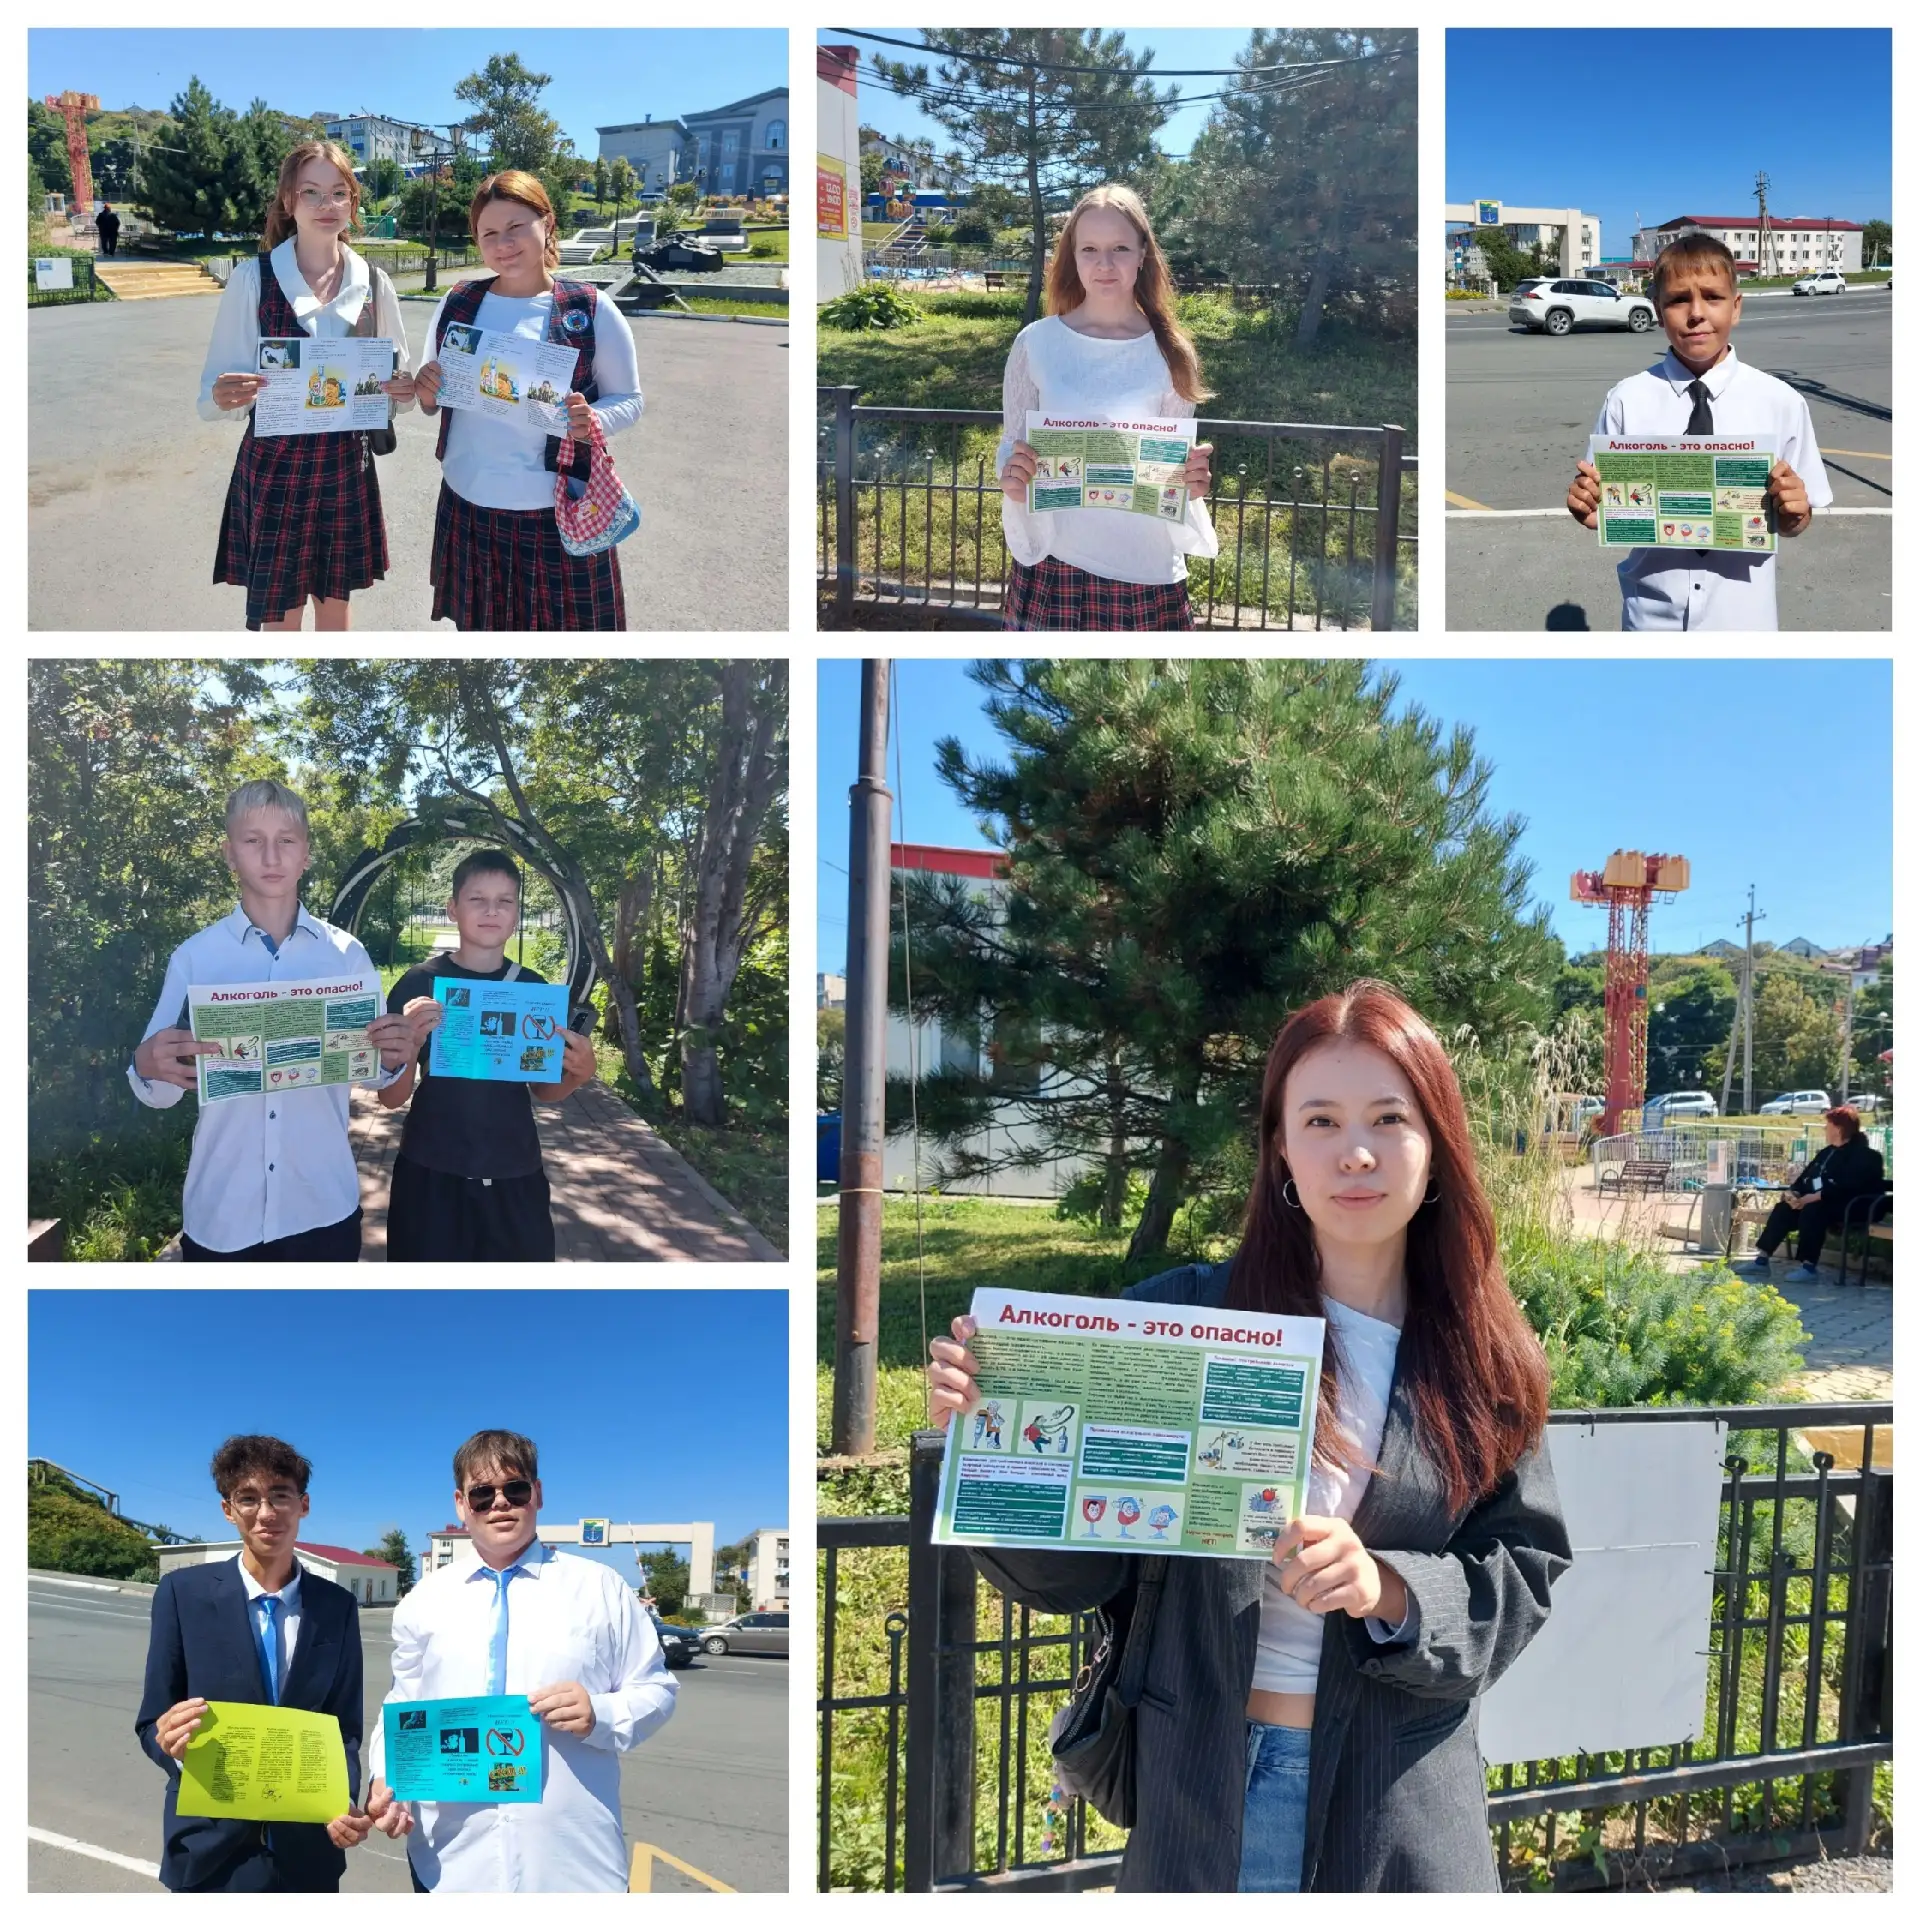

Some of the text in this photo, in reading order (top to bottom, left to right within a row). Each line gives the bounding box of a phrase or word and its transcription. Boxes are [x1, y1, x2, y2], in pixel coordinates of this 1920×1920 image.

[1043, 417, 1100, 428] Алкоголь
[1109, 421, 1129, 429] это
[1132, 422, 1178, 433] опасно!
[1609, 441, 1668, 450] Алкоголь
[1680, 442, 1701, 450] это
[1704, 441, 1755, 450] опасно!
[210, 991, 278, 1001] Алкоголь
[290, 988, 313, 997] это
[316, 981, 363, 995] опасно!
[999, 1304, 1119, 1332] Алкоголь
[1143, 1320, 1184, 1337] это
[1190, 1324, 1283, 1347] опасно!
